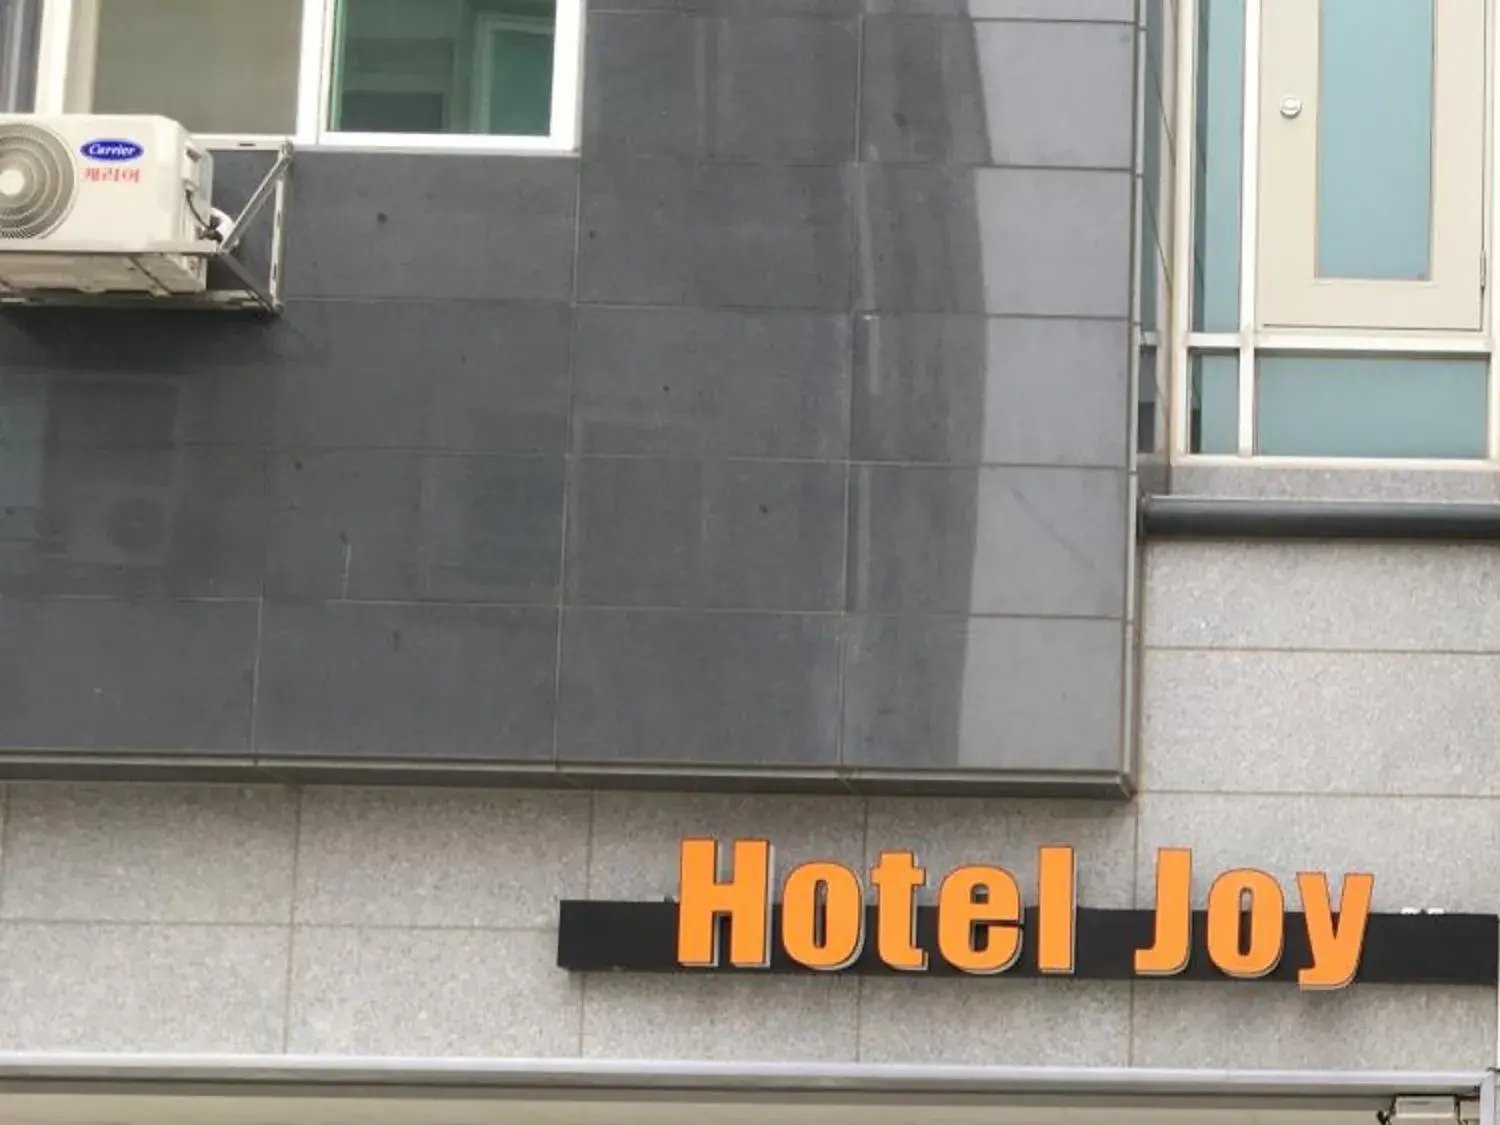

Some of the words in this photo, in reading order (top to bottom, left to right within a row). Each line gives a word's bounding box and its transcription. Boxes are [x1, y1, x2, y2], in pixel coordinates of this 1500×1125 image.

[89, 143, 136, 156] Carrier
[676, 837, 1077, 973] Hotel
[1133, 846, 1375, 988] Joy
